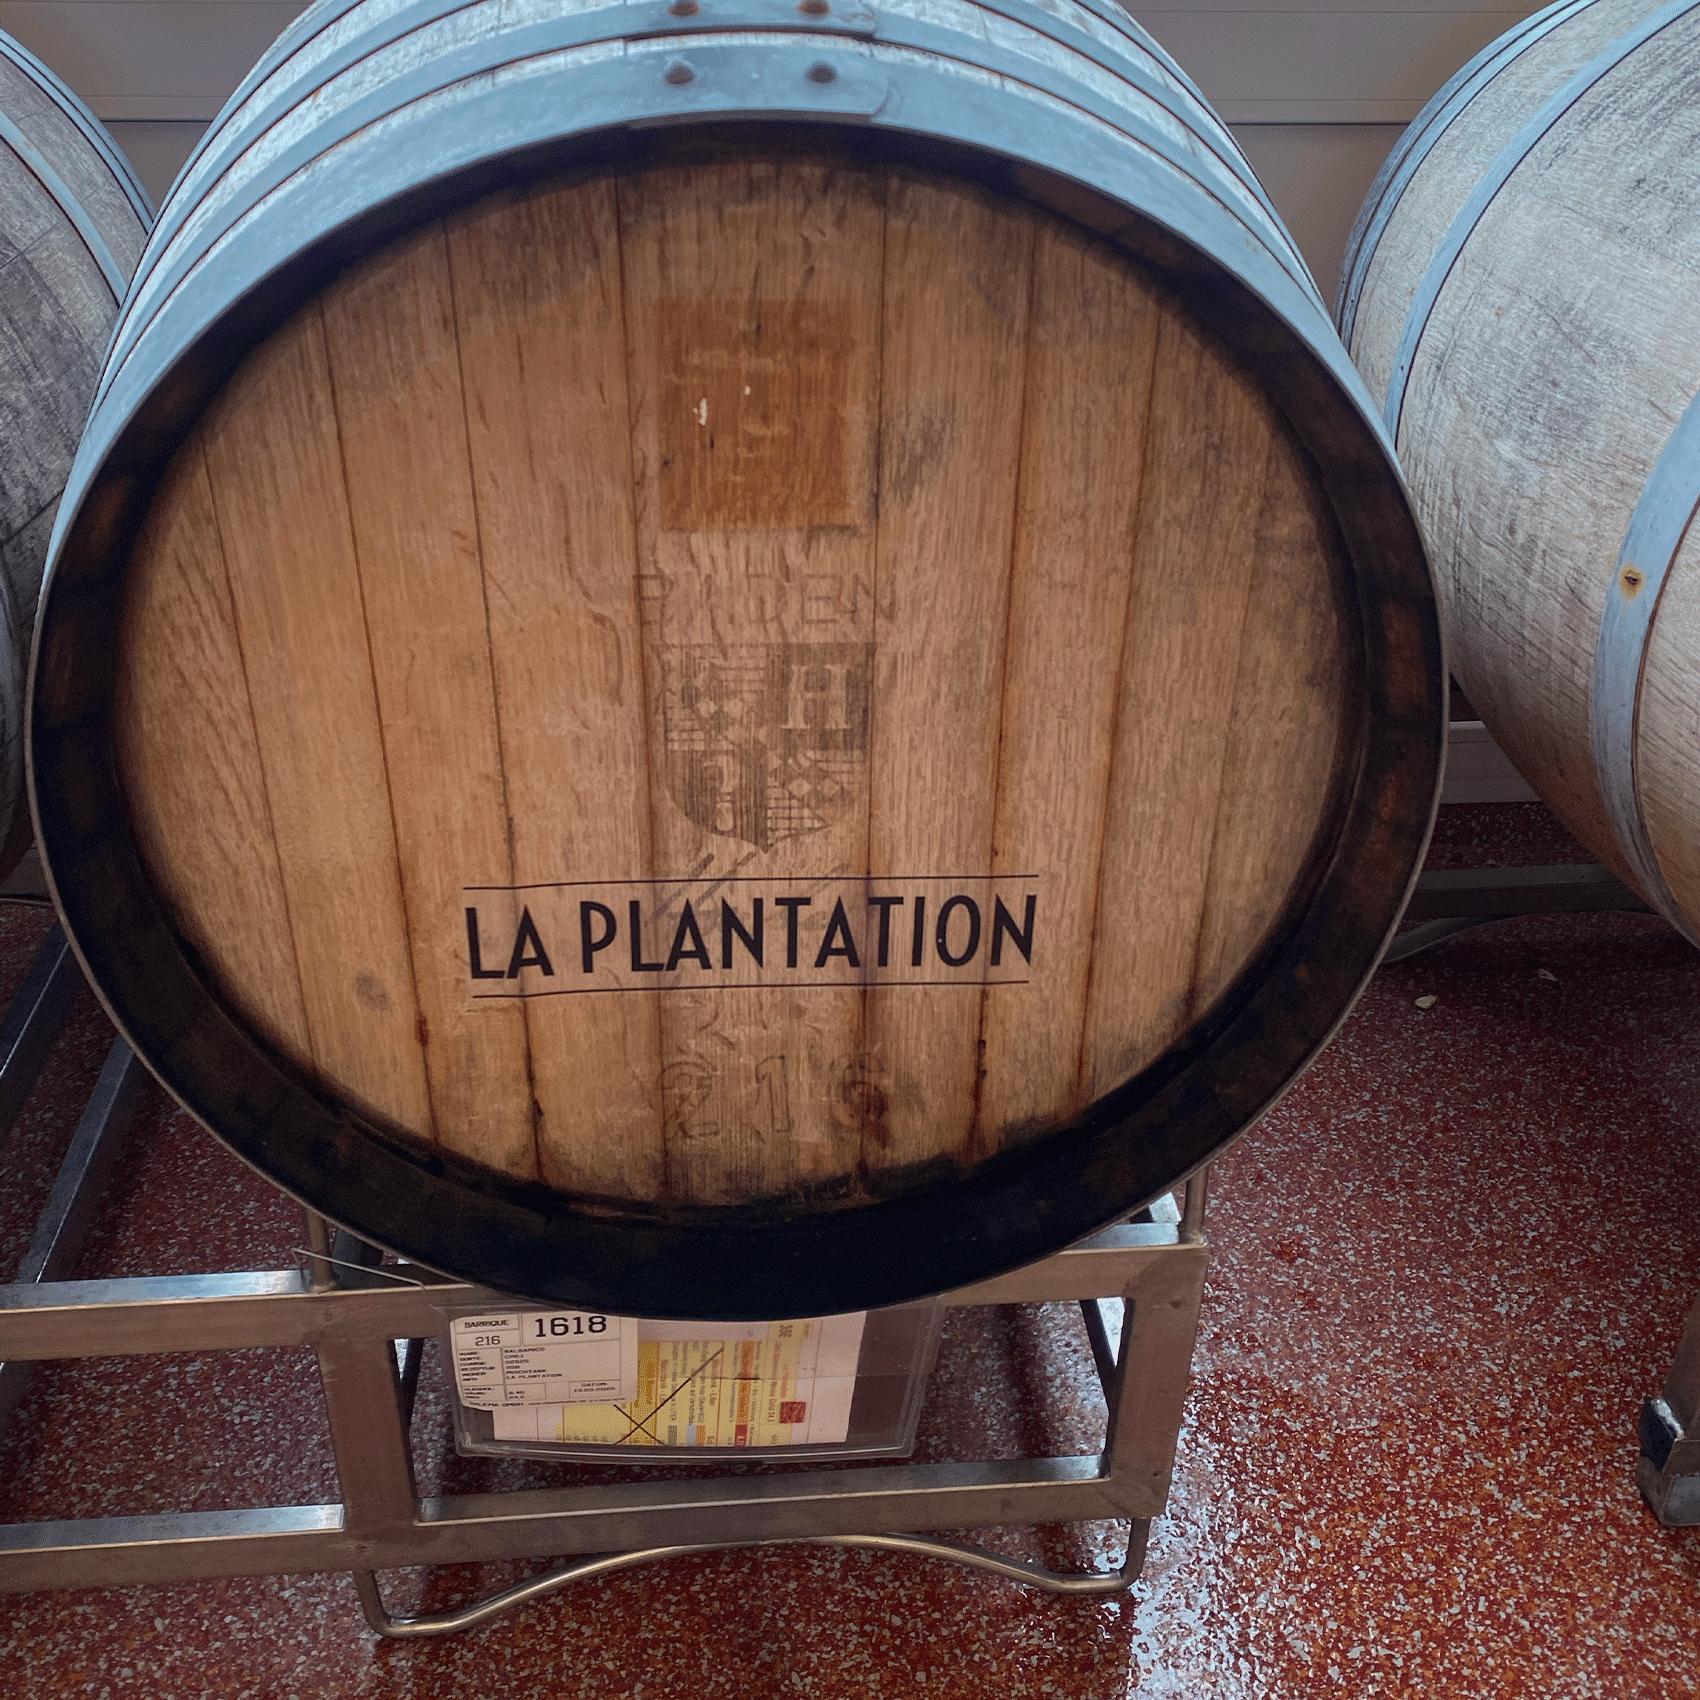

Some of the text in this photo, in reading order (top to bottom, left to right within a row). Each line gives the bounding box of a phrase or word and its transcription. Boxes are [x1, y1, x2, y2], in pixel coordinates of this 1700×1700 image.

[465, 894, 1037, 979] LA PLANTATION
[464, 1319, 510, 1329] BARRIQUE
[535, 1315, 608, 1338] 1618
[475, 1335, 501, 1346] 216
